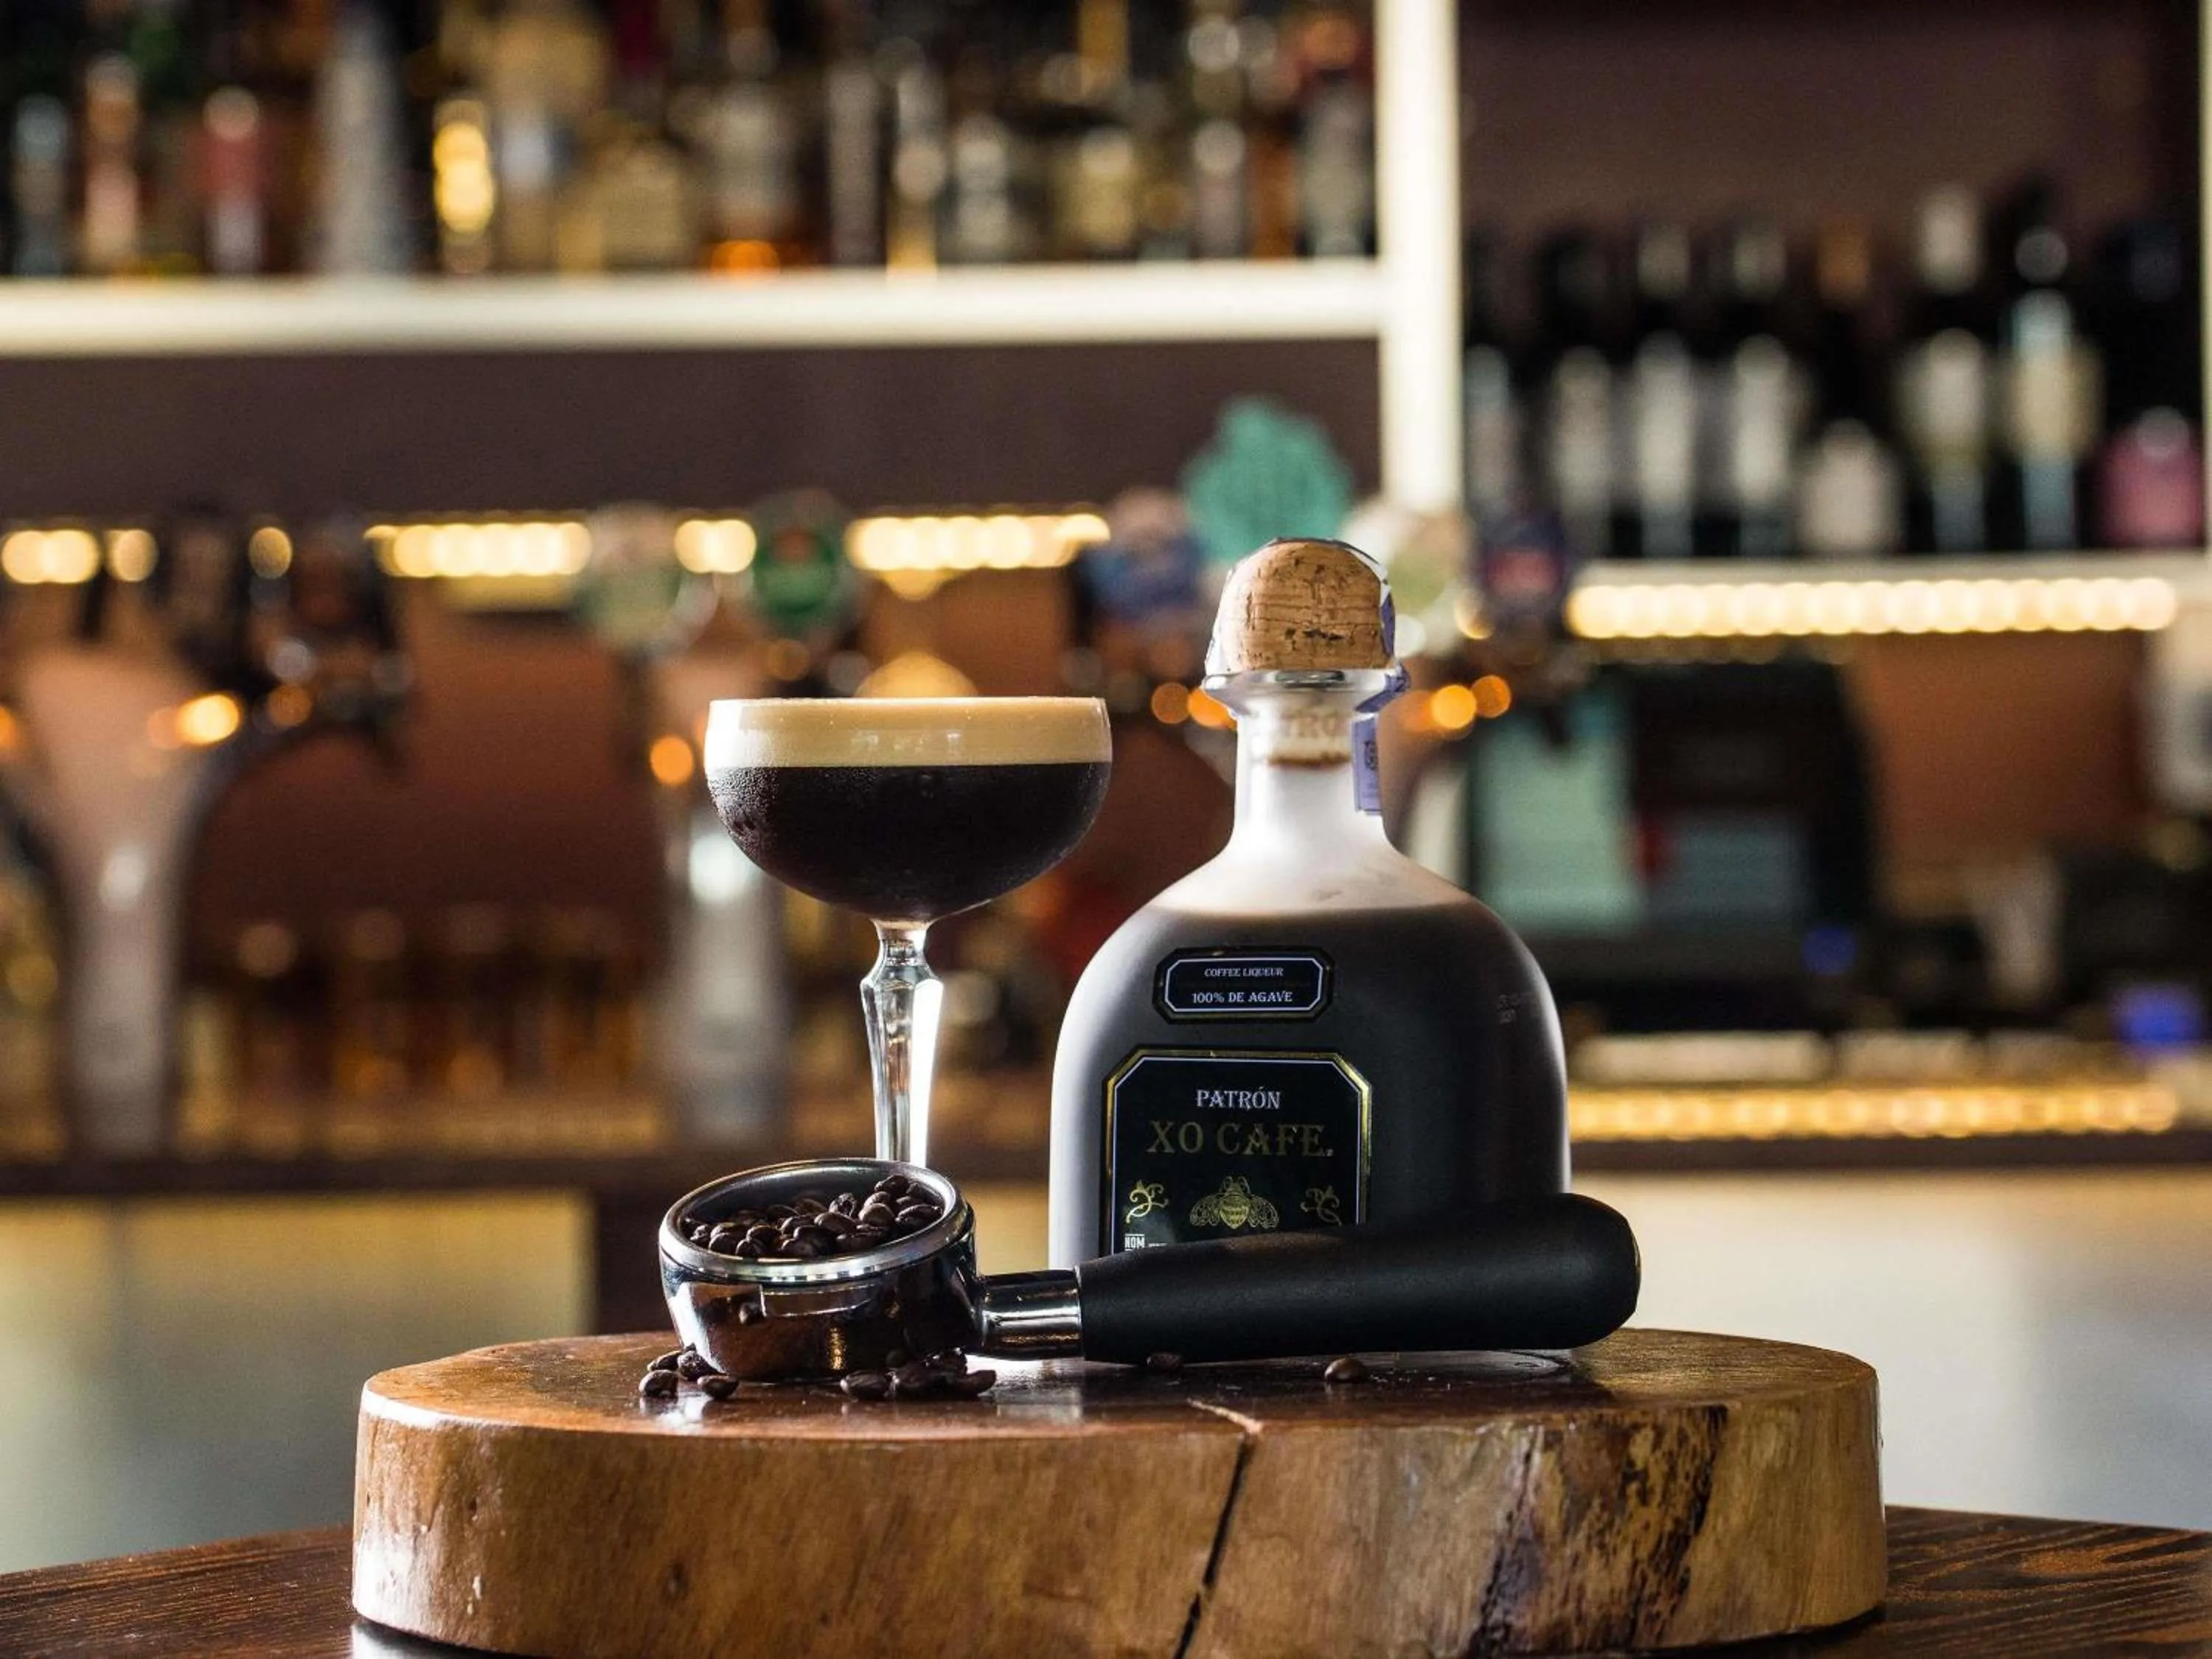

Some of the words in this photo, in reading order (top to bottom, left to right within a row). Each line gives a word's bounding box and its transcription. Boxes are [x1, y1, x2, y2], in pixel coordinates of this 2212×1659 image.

[1204, 967, 1241, 977] COFFEE
[1242, 967, 1284, 977] LIQUEUR
[1191, 992, 1225, 1004] 100%
[1228, 992, 1245, 1003] DE
[1248, 990, 1293, 1003] AGAVE
[1195, 1085, 1281, 1110] PATRÓN
[1147, 1120, 1204, 1154] XO
[1124, 1236, 1145, 1248] NOM
